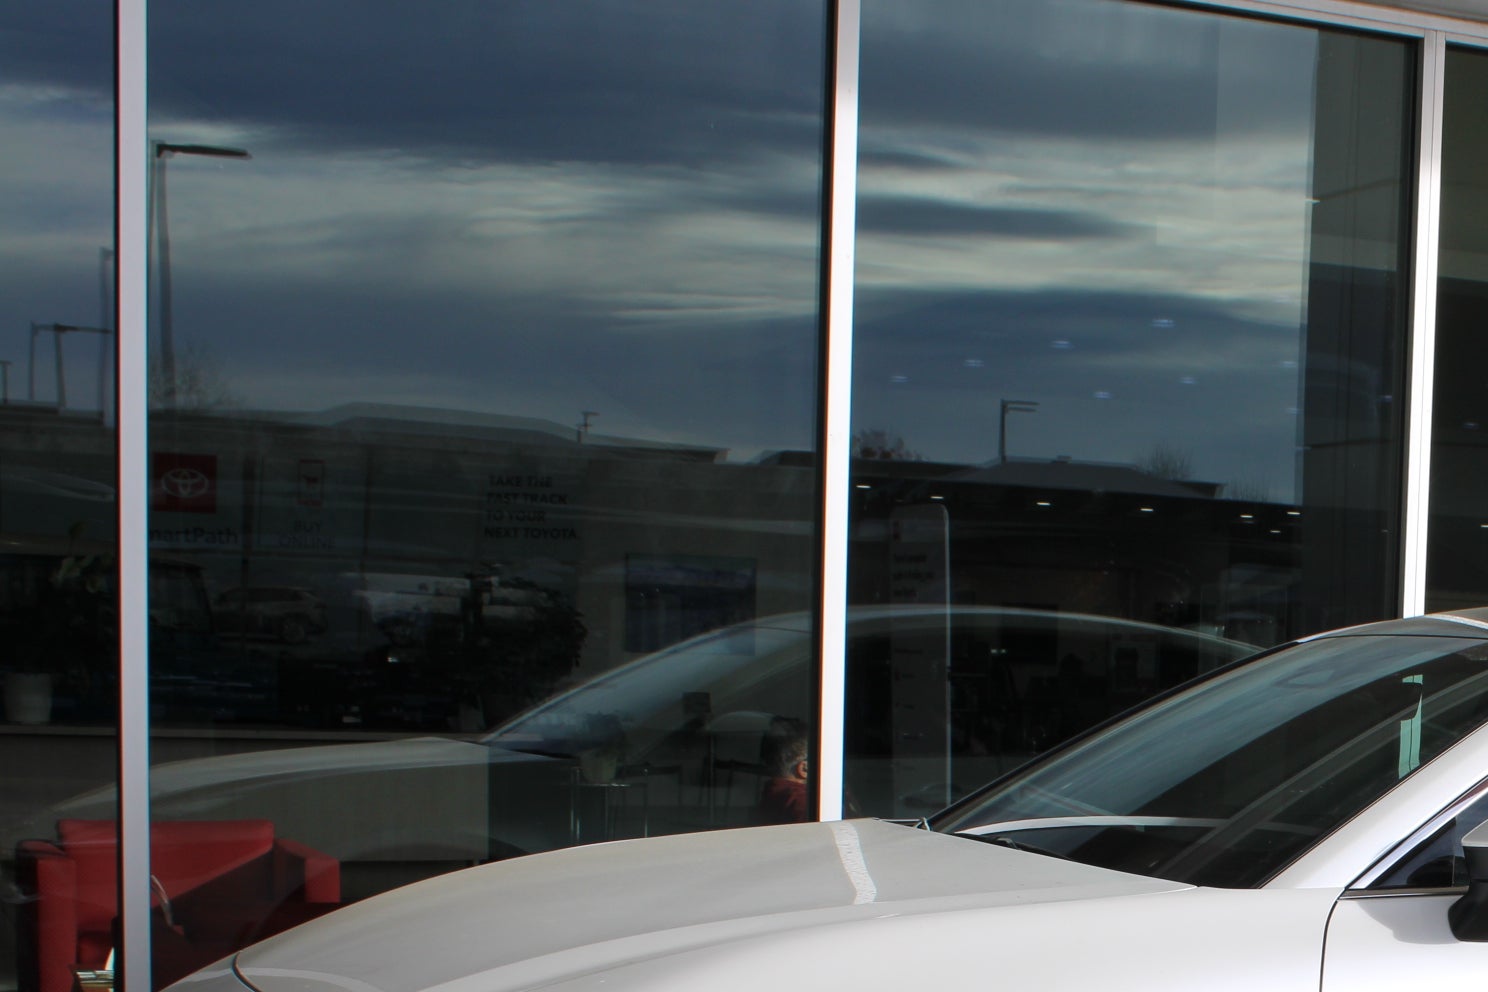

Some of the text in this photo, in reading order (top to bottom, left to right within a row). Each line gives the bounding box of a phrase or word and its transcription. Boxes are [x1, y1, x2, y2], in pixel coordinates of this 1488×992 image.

[488, 475, 552, 488] TAKE THE
[487, 492, 568, 505] FAST TRACK
[487, 510, 545, 521] TO YOUR
[484, 527, 519, 539] NEXT
